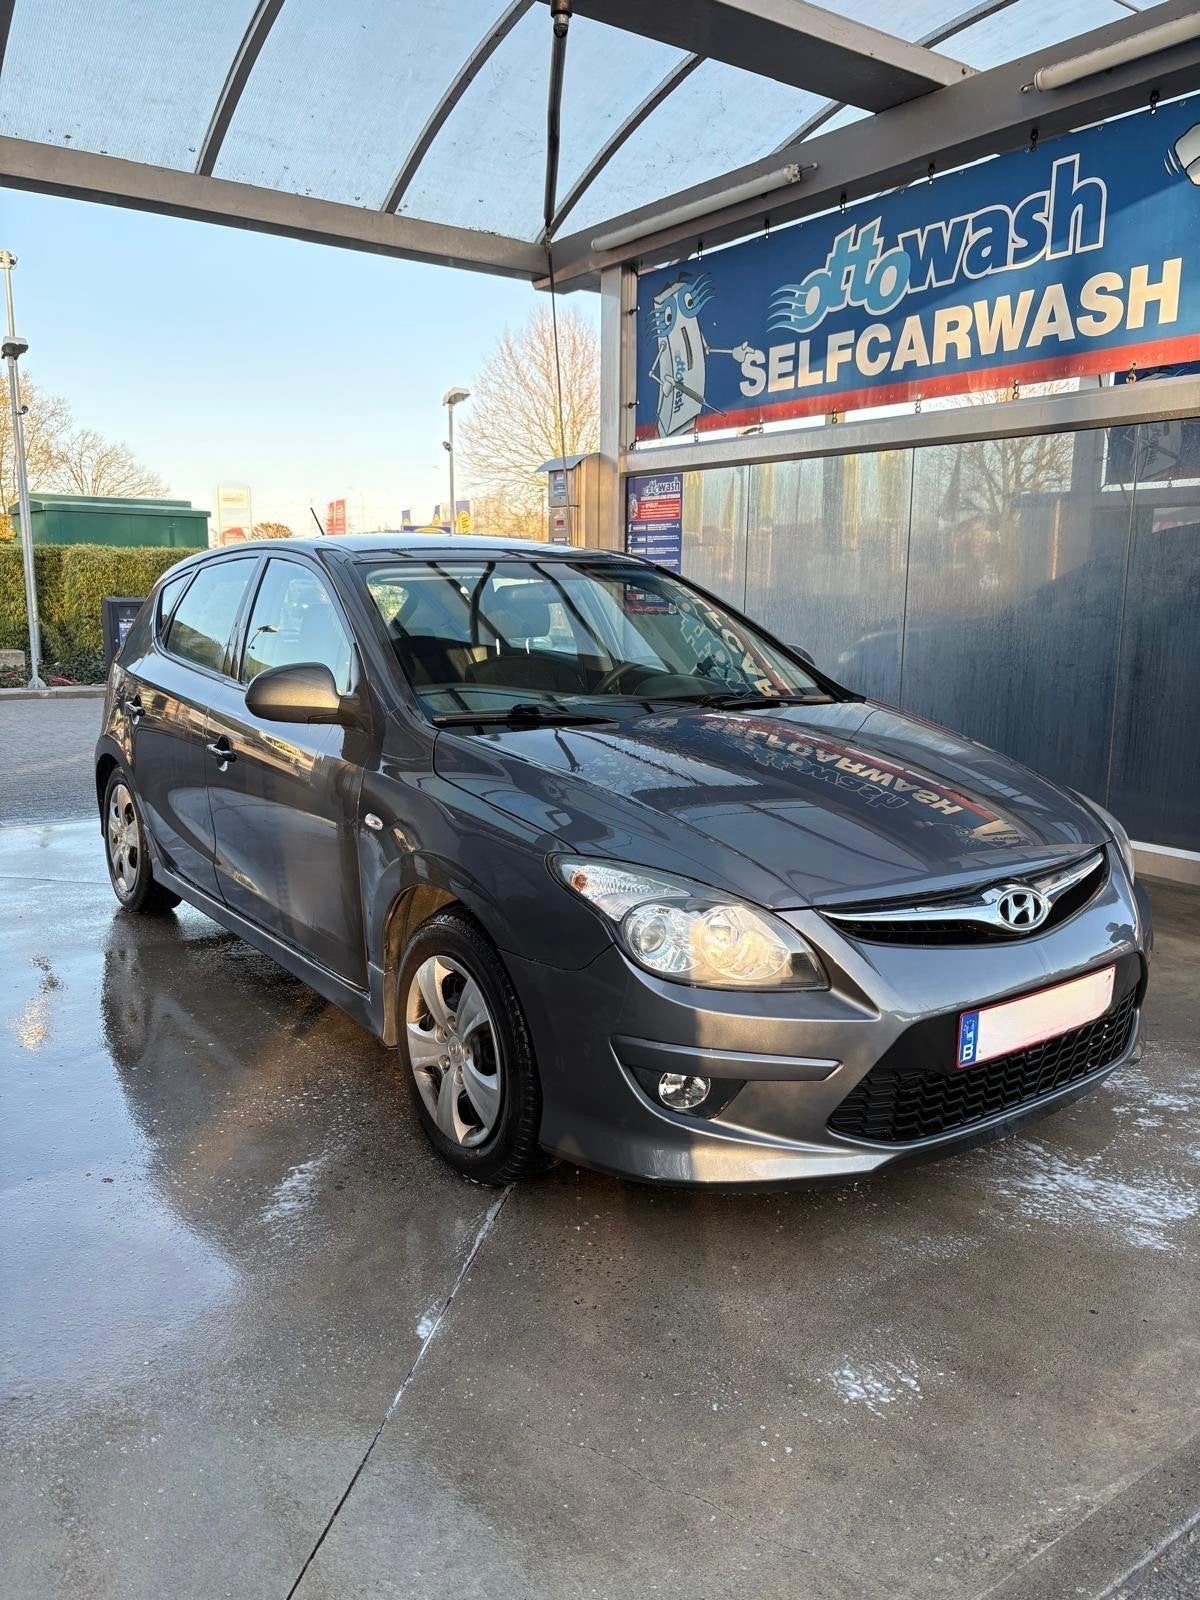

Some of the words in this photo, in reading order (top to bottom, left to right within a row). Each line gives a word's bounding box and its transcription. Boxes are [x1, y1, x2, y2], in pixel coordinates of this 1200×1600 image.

[767, 153, 1108, 333] ottowash
[739, 258, 1182, 397] SELFCARWASH
[963, 1044, 974, 1061] B
